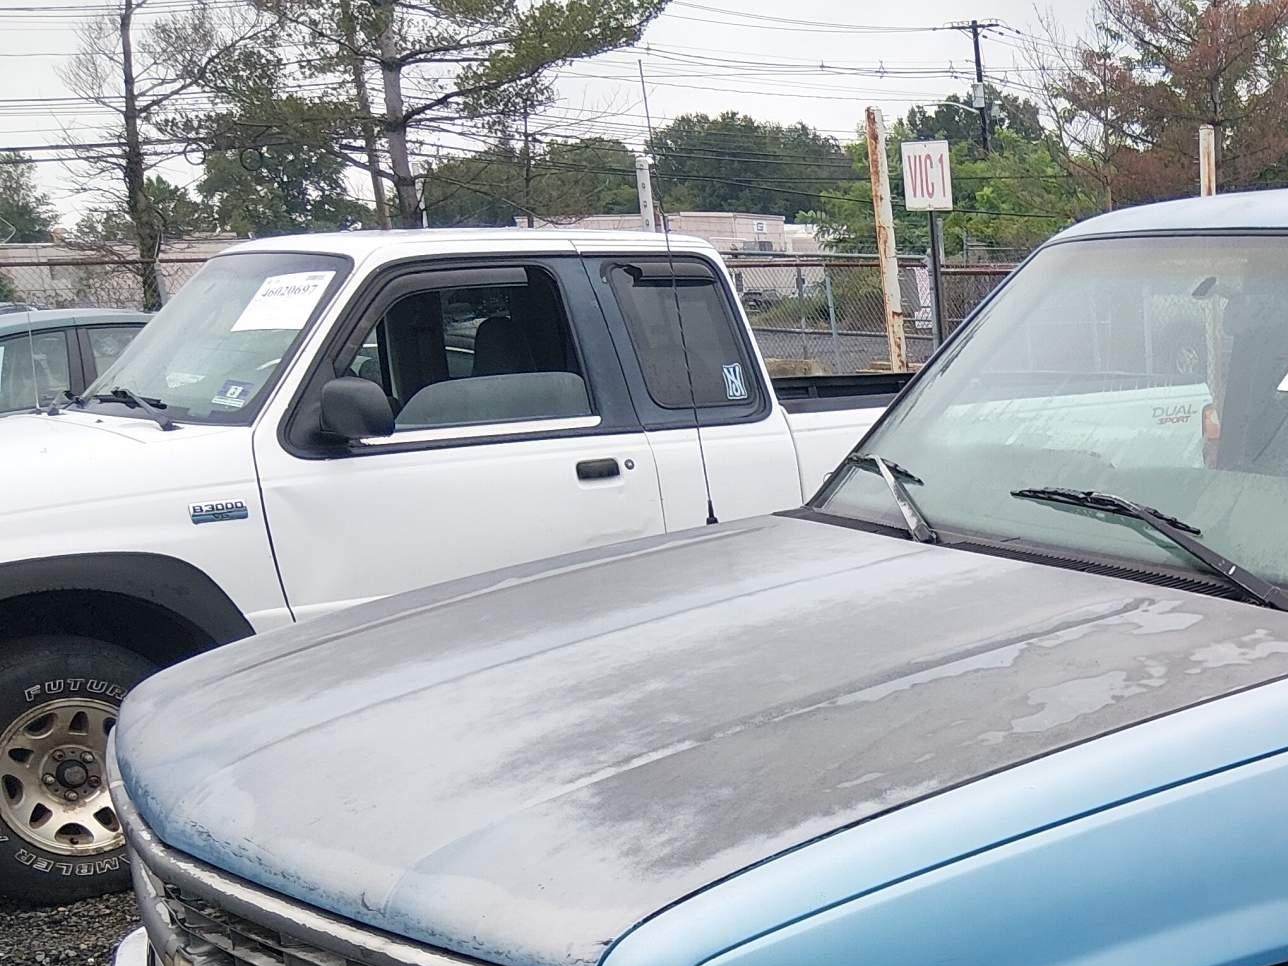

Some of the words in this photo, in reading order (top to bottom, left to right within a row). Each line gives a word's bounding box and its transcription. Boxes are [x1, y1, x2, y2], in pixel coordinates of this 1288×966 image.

[907, 153, 935, 199] VIC
[938, 153, 946, 198] 1
[1151, 404, 1198, 418] DUAL
[1156, 415, 1192, 425] SPORT
[192, 501, 245, 513] B3000
